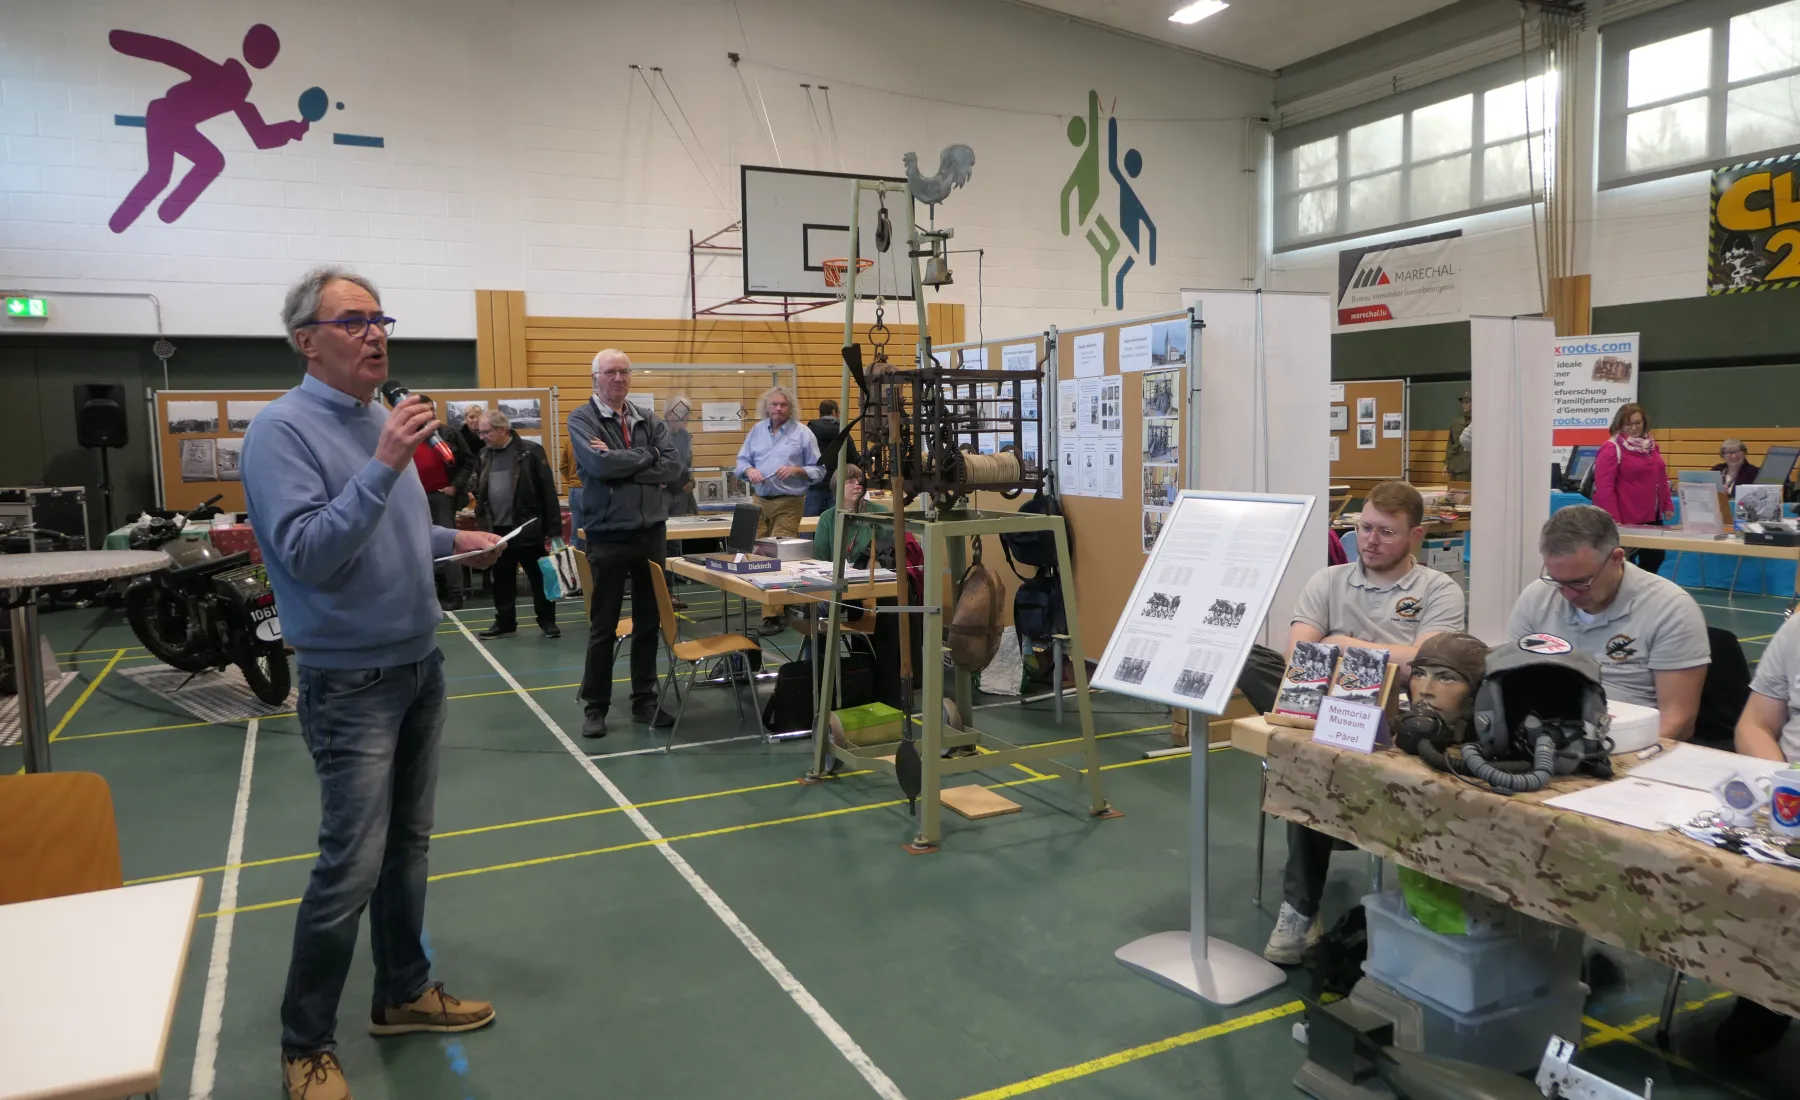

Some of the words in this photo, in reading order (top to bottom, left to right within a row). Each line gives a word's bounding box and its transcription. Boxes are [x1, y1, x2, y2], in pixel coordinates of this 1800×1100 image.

[1395, 264, 1455, 283] MARECHAL
[1350, 309, 1387, 319] marechal.lu
[1554, 342, 1632, 355] xroots.com
[1554, 388, 1607, 396] efuerschung
[1555, 397, 1632, 405] 'Familljefuerscher
[1553, 417, 1608, 426] roots.com
[748, 562, 772, 570] Diekirch
[268, 621, 281, 636] L
[1328, 705, 1371, 720] Memorial
[1329, 715, 1365, 729] Museum
[1335, 731, 1359, 743] Pärel
